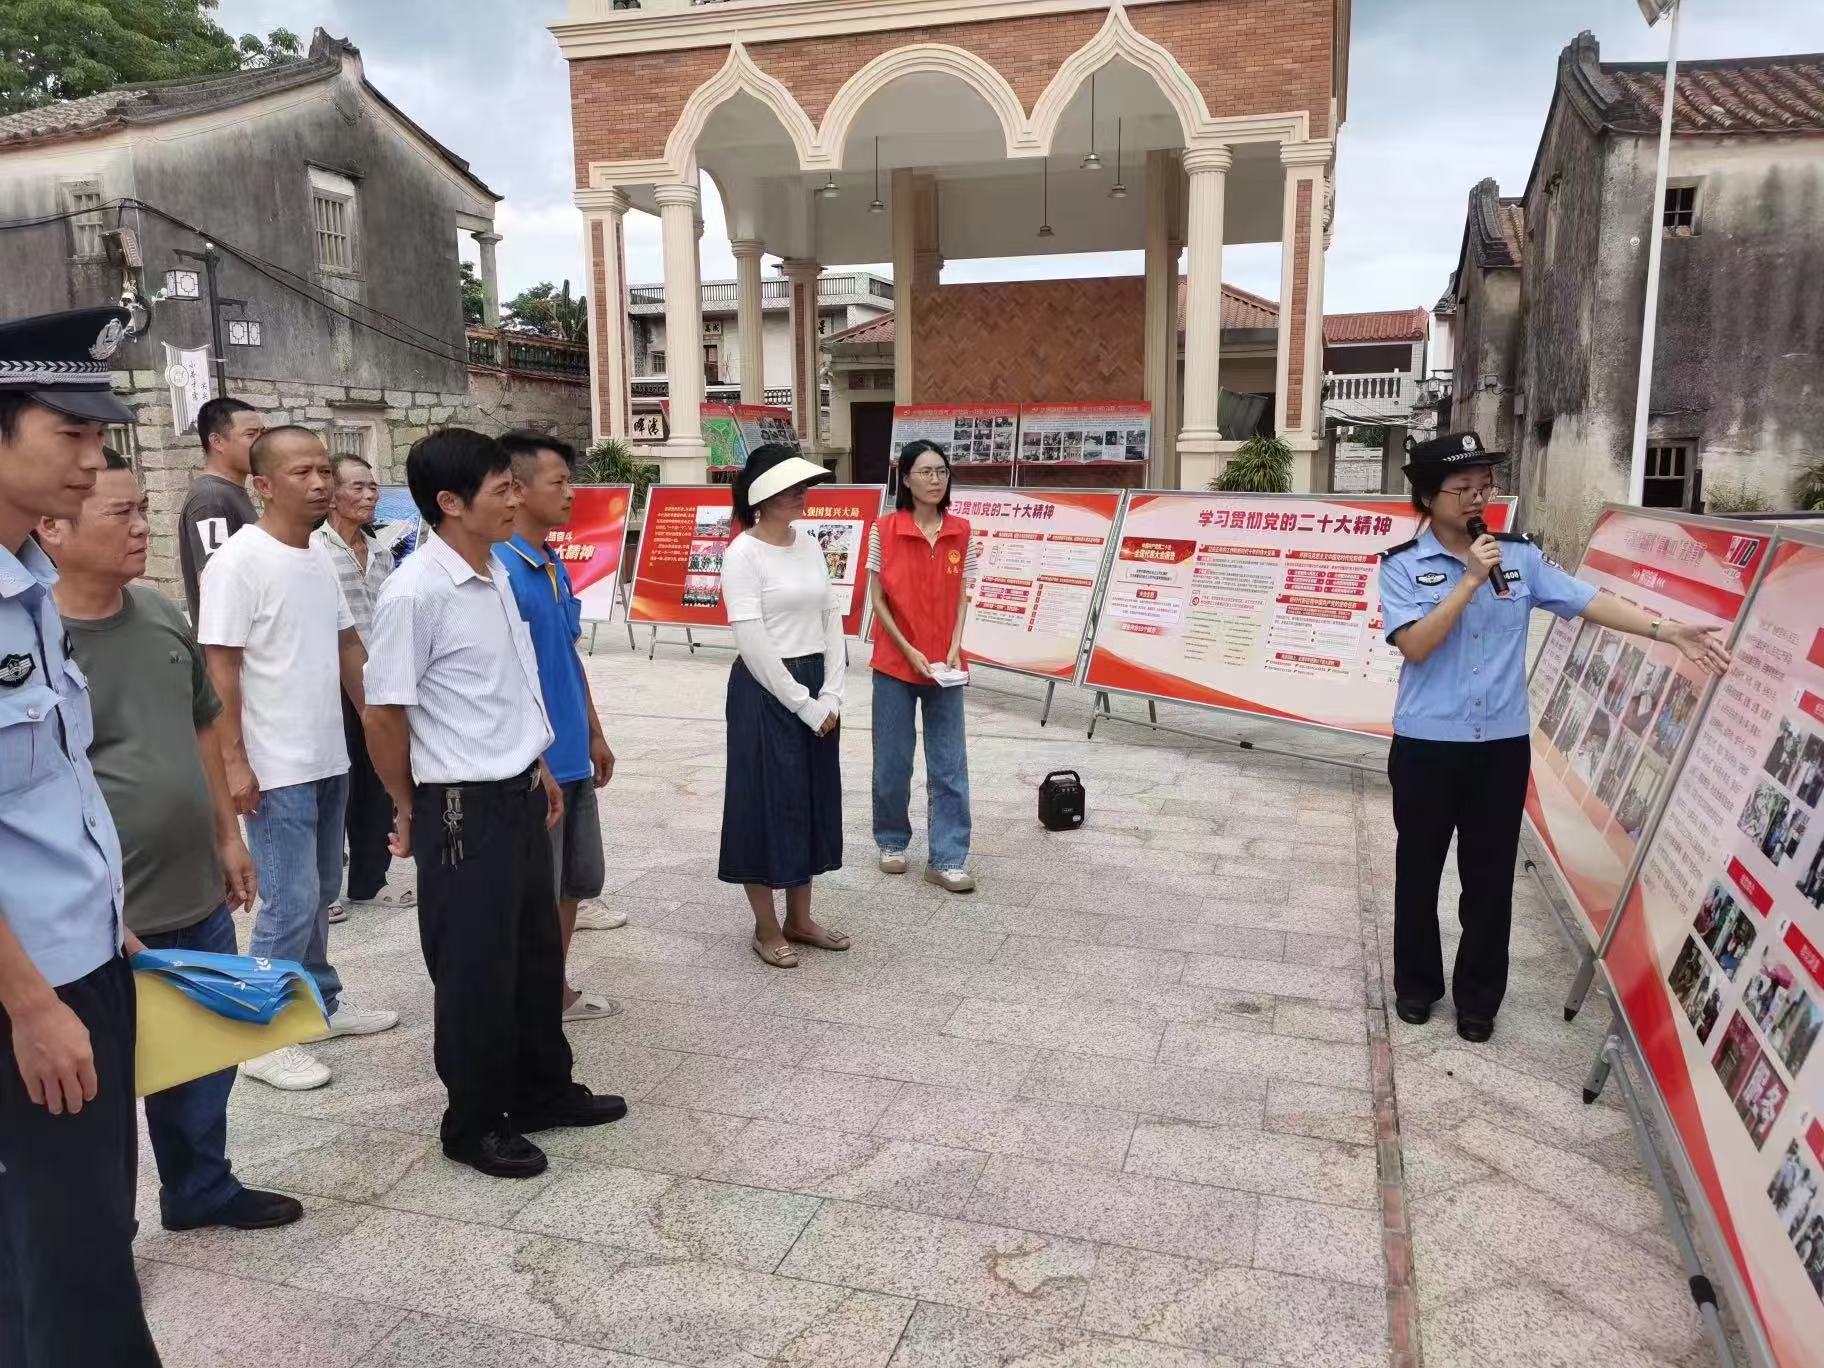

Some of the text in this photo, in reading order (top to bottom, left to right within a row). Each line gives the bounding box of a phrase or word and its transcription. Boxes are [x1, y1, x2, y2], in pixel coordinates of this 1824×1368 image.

[803, 507, 860, 518] 强国复兴大局
[1198, 509, 1393, 536] 学习贯彻党的二十大精神
[544, 531, 572, 542] 结奋斗
